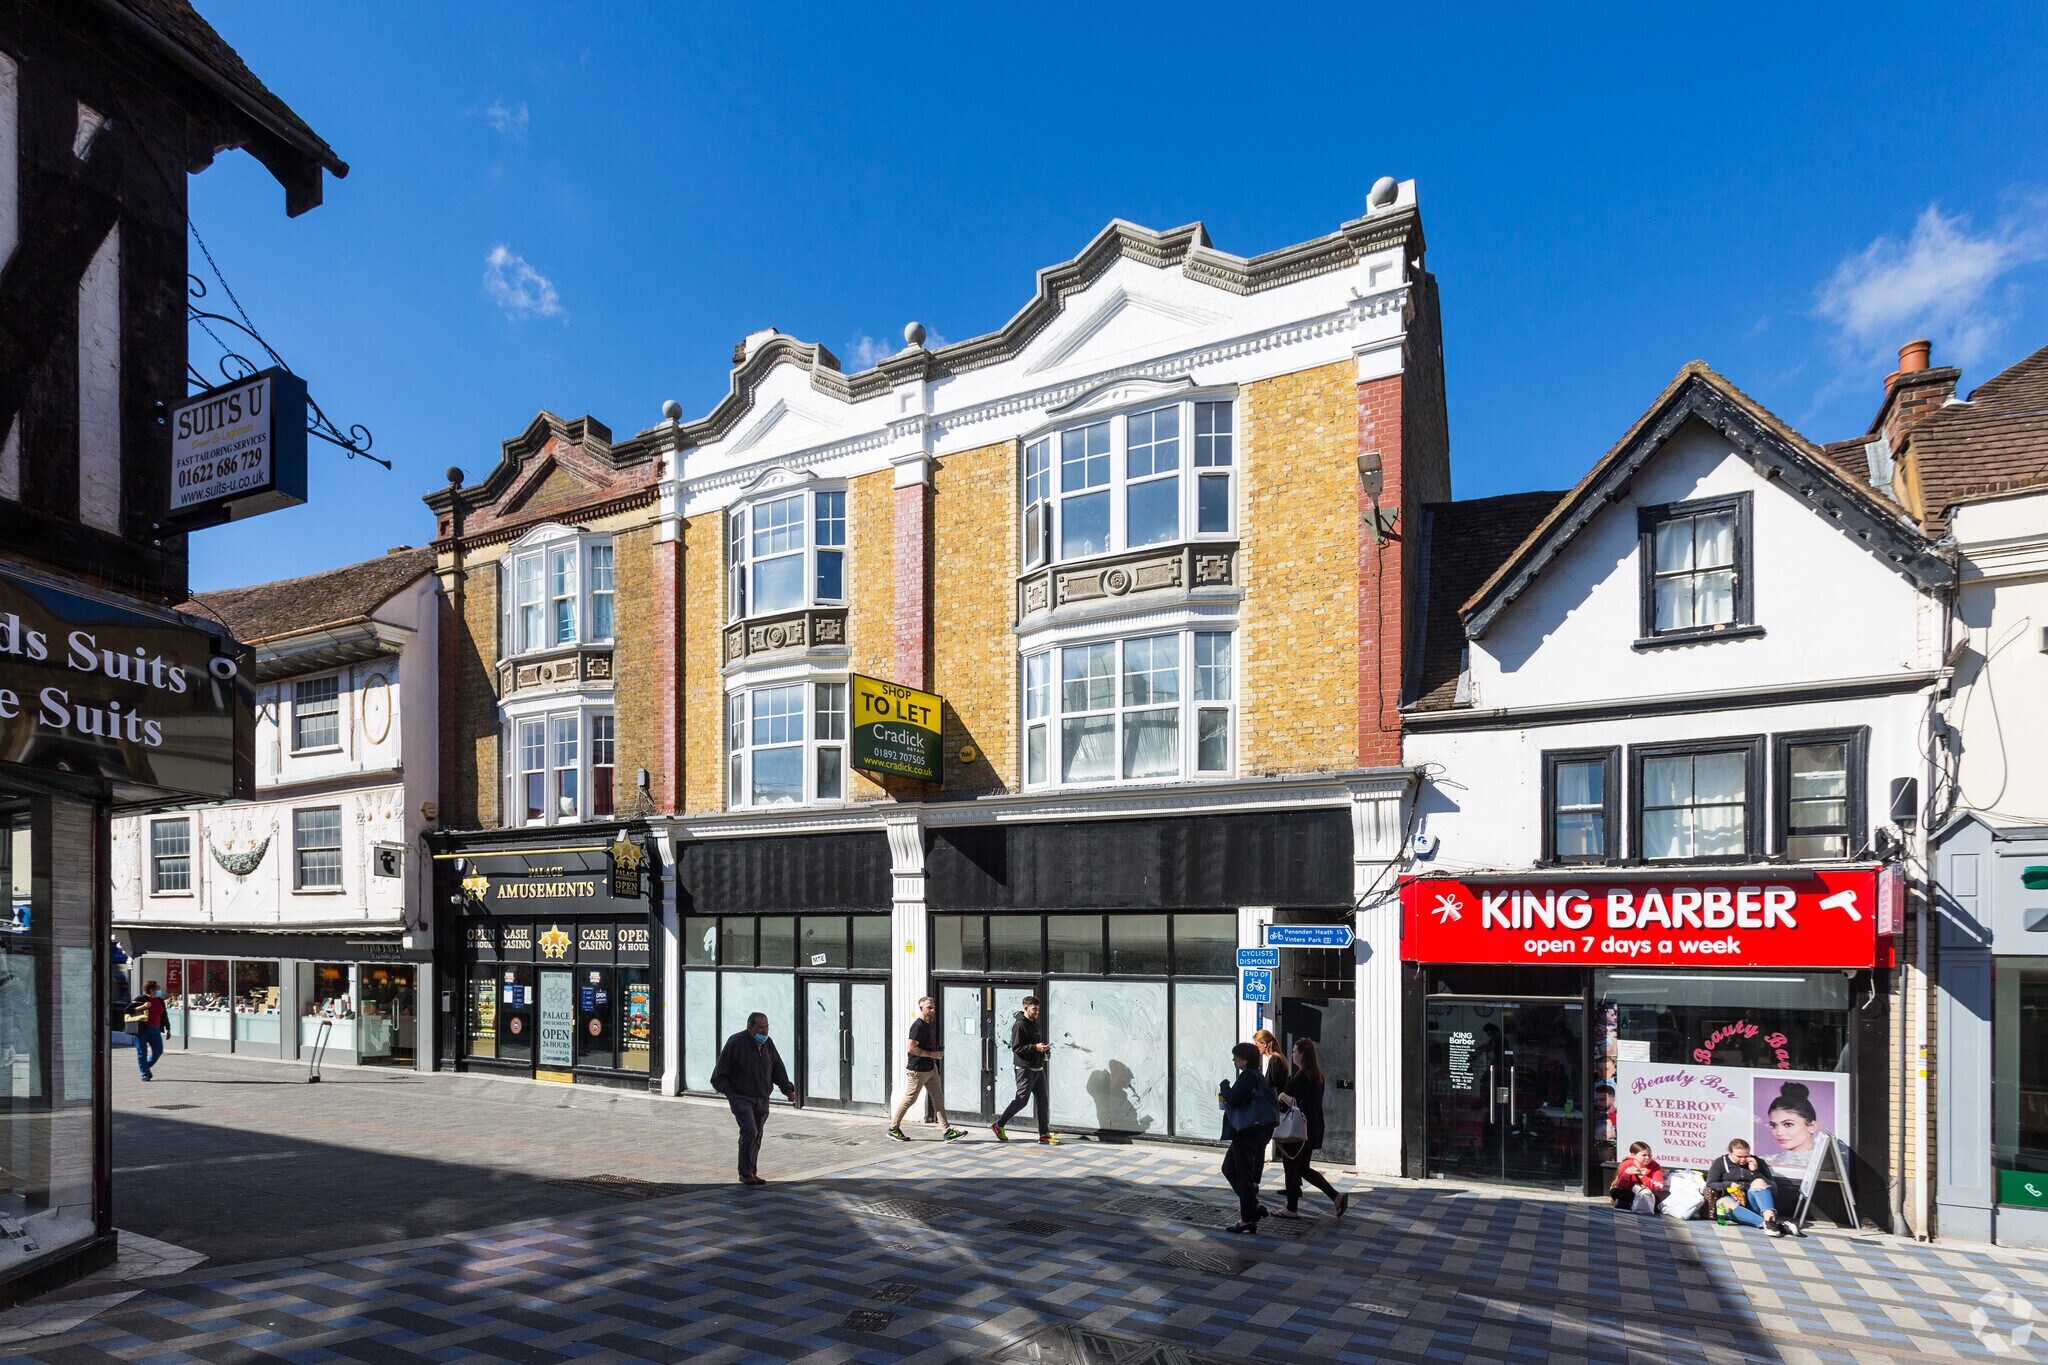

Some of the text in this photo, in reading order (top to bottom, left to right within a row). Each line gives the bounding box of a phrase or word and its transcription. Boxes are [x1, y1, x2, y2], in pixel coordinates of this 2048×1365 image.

[178, 384, 264, 440] SUITS U
[176, 432, 267, 468] FAST TAILORING SERVICES
[178, 447, 262, 488] 01622 686 729
[180, 469, 265, 505] www.suits-u.co.uk
[68, 630, 187, 694] Suits
[882, 684, 912, 700] SHOP
[861, 691, 931, 725] TO LET
[39, 687, 163, 747] Suits
[873, 723, 925, 749] Cradick
[874, 747, 925, 766] 01892 707505
[863, 757, 933, 776] www.cradick.co.uk
[528, 866, 564, 878] PALACE
[615, 869, 638, 878] PALACE
[497, 881, 595, 899] AMUSEMENTS
[615, 880, 637, 890] OPEN
[1481, 885, 1798, 930] KING BARBER
[466, 929, 496, 940] OPEN
[503, 929, 529, 939] CASH
[581, 929, 609, 940] CASH
[618, 929, 650, 942] OPEN
[477, 941, 496, 949] HOURS
[501, 939, 531, 949] CASINO
[579, 940, 613, 951] CASINO
[618, 943, 626, 951] 24
[1524, 935, 1741, 957] open 7 days a week
[1245, 993, 1267, 1001] ROUTE
[542, 1011, 570, 1020] PALACE
[542, 1028, 570, 1040] OPEN
[549, 1041, 570, 1049] HOURS
[1449, 1036, 1476, 1045] Barber
[1693, 1019, 1759, 1065] Beauty
[1764, 1032, 1790, 1069] Bar
[1631, 1069, 1740, 1099] Beauty Bar
[1643, 1098, 1726, 1113] EYEBROW
[1654, 1110, 1716, 1121] THREADING
[1661, 1119, 1707, 1130] SHAPING
[1662, 1128, 1706, 1139] TINTING
[1663, 1138, 1706, 1148] WAXING
[1654, 1154, 1681, 1162] ADIES
